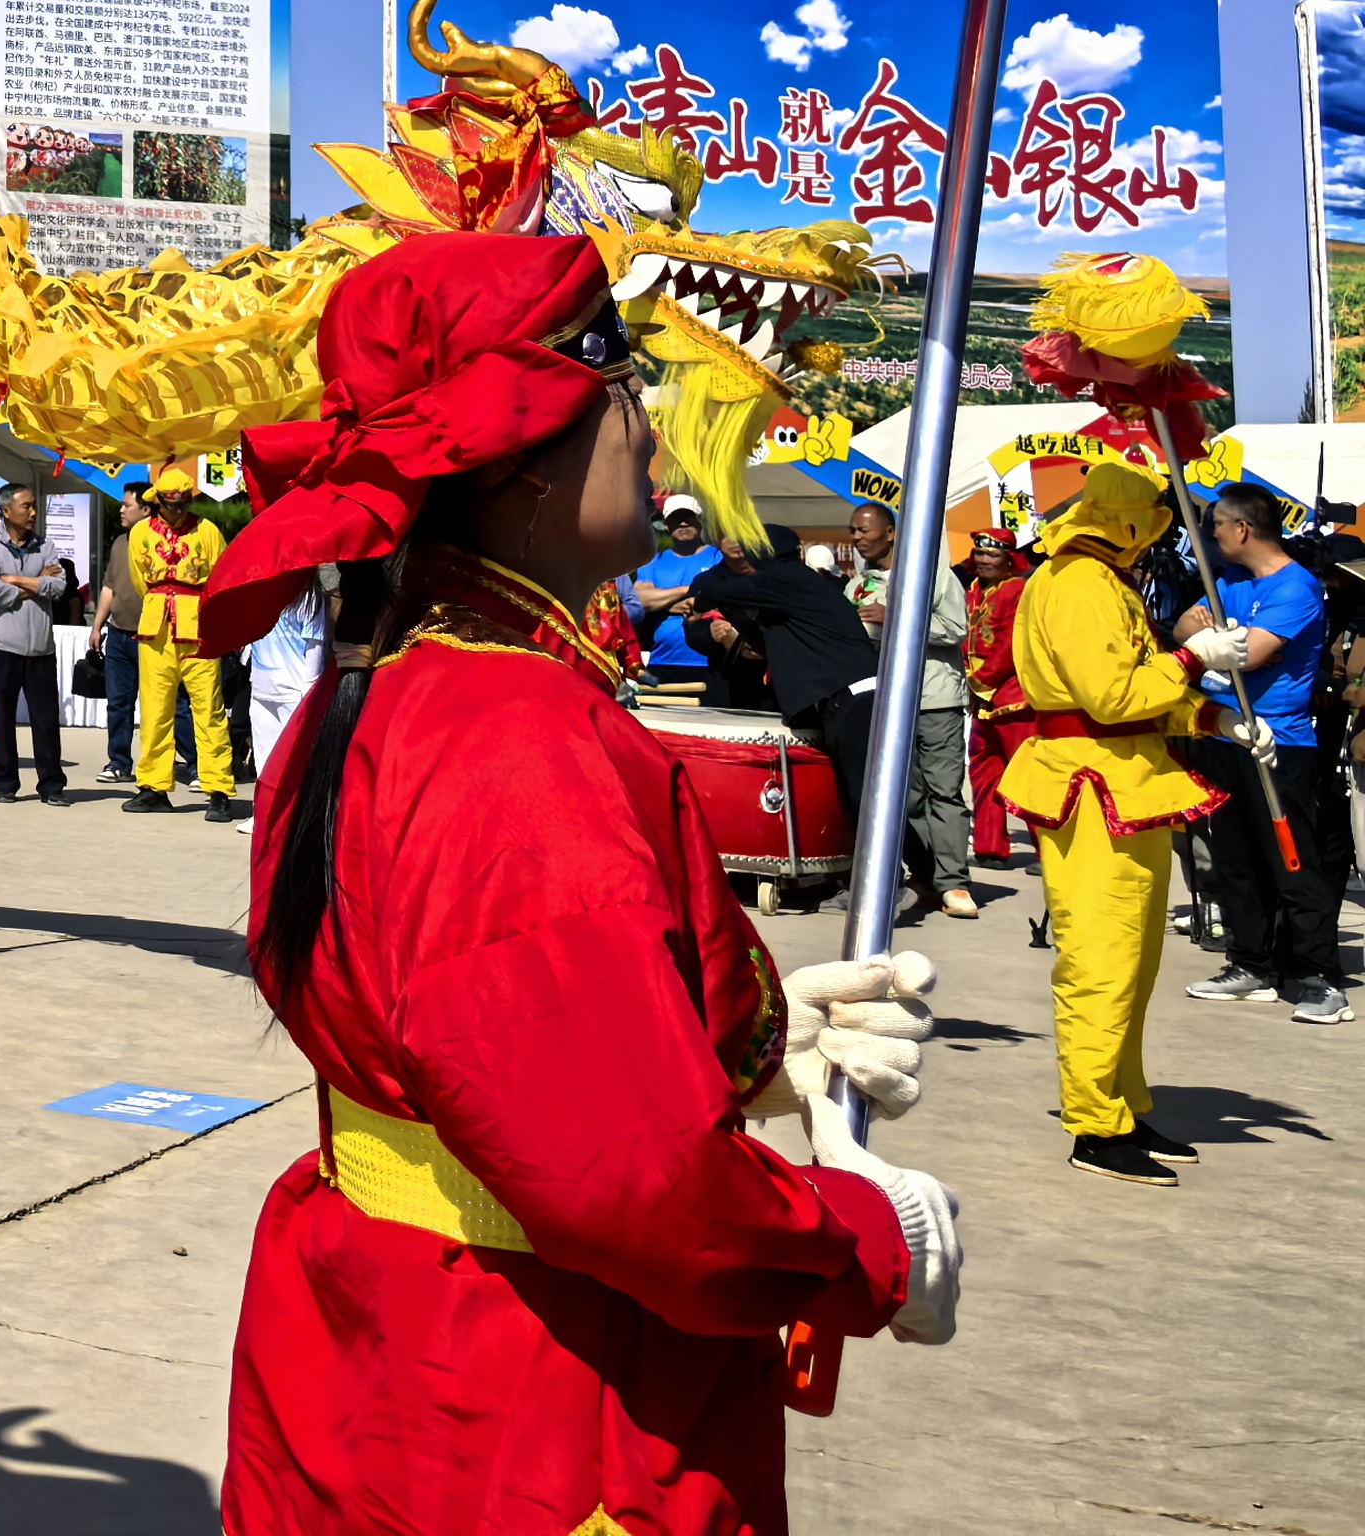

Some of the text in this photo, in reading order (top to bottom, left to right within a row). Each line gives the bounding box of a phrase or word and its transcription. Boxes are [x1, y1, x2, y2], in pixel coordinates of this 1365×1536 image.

[780, 88, 833, 206] 就是
[842, 357, 1012, 391] 中共中员会
[1014, 435, 1105, 457] 越吃越有
[854, 471, 900, 510] WOW
[995, 482, 1034, 512] 美食
